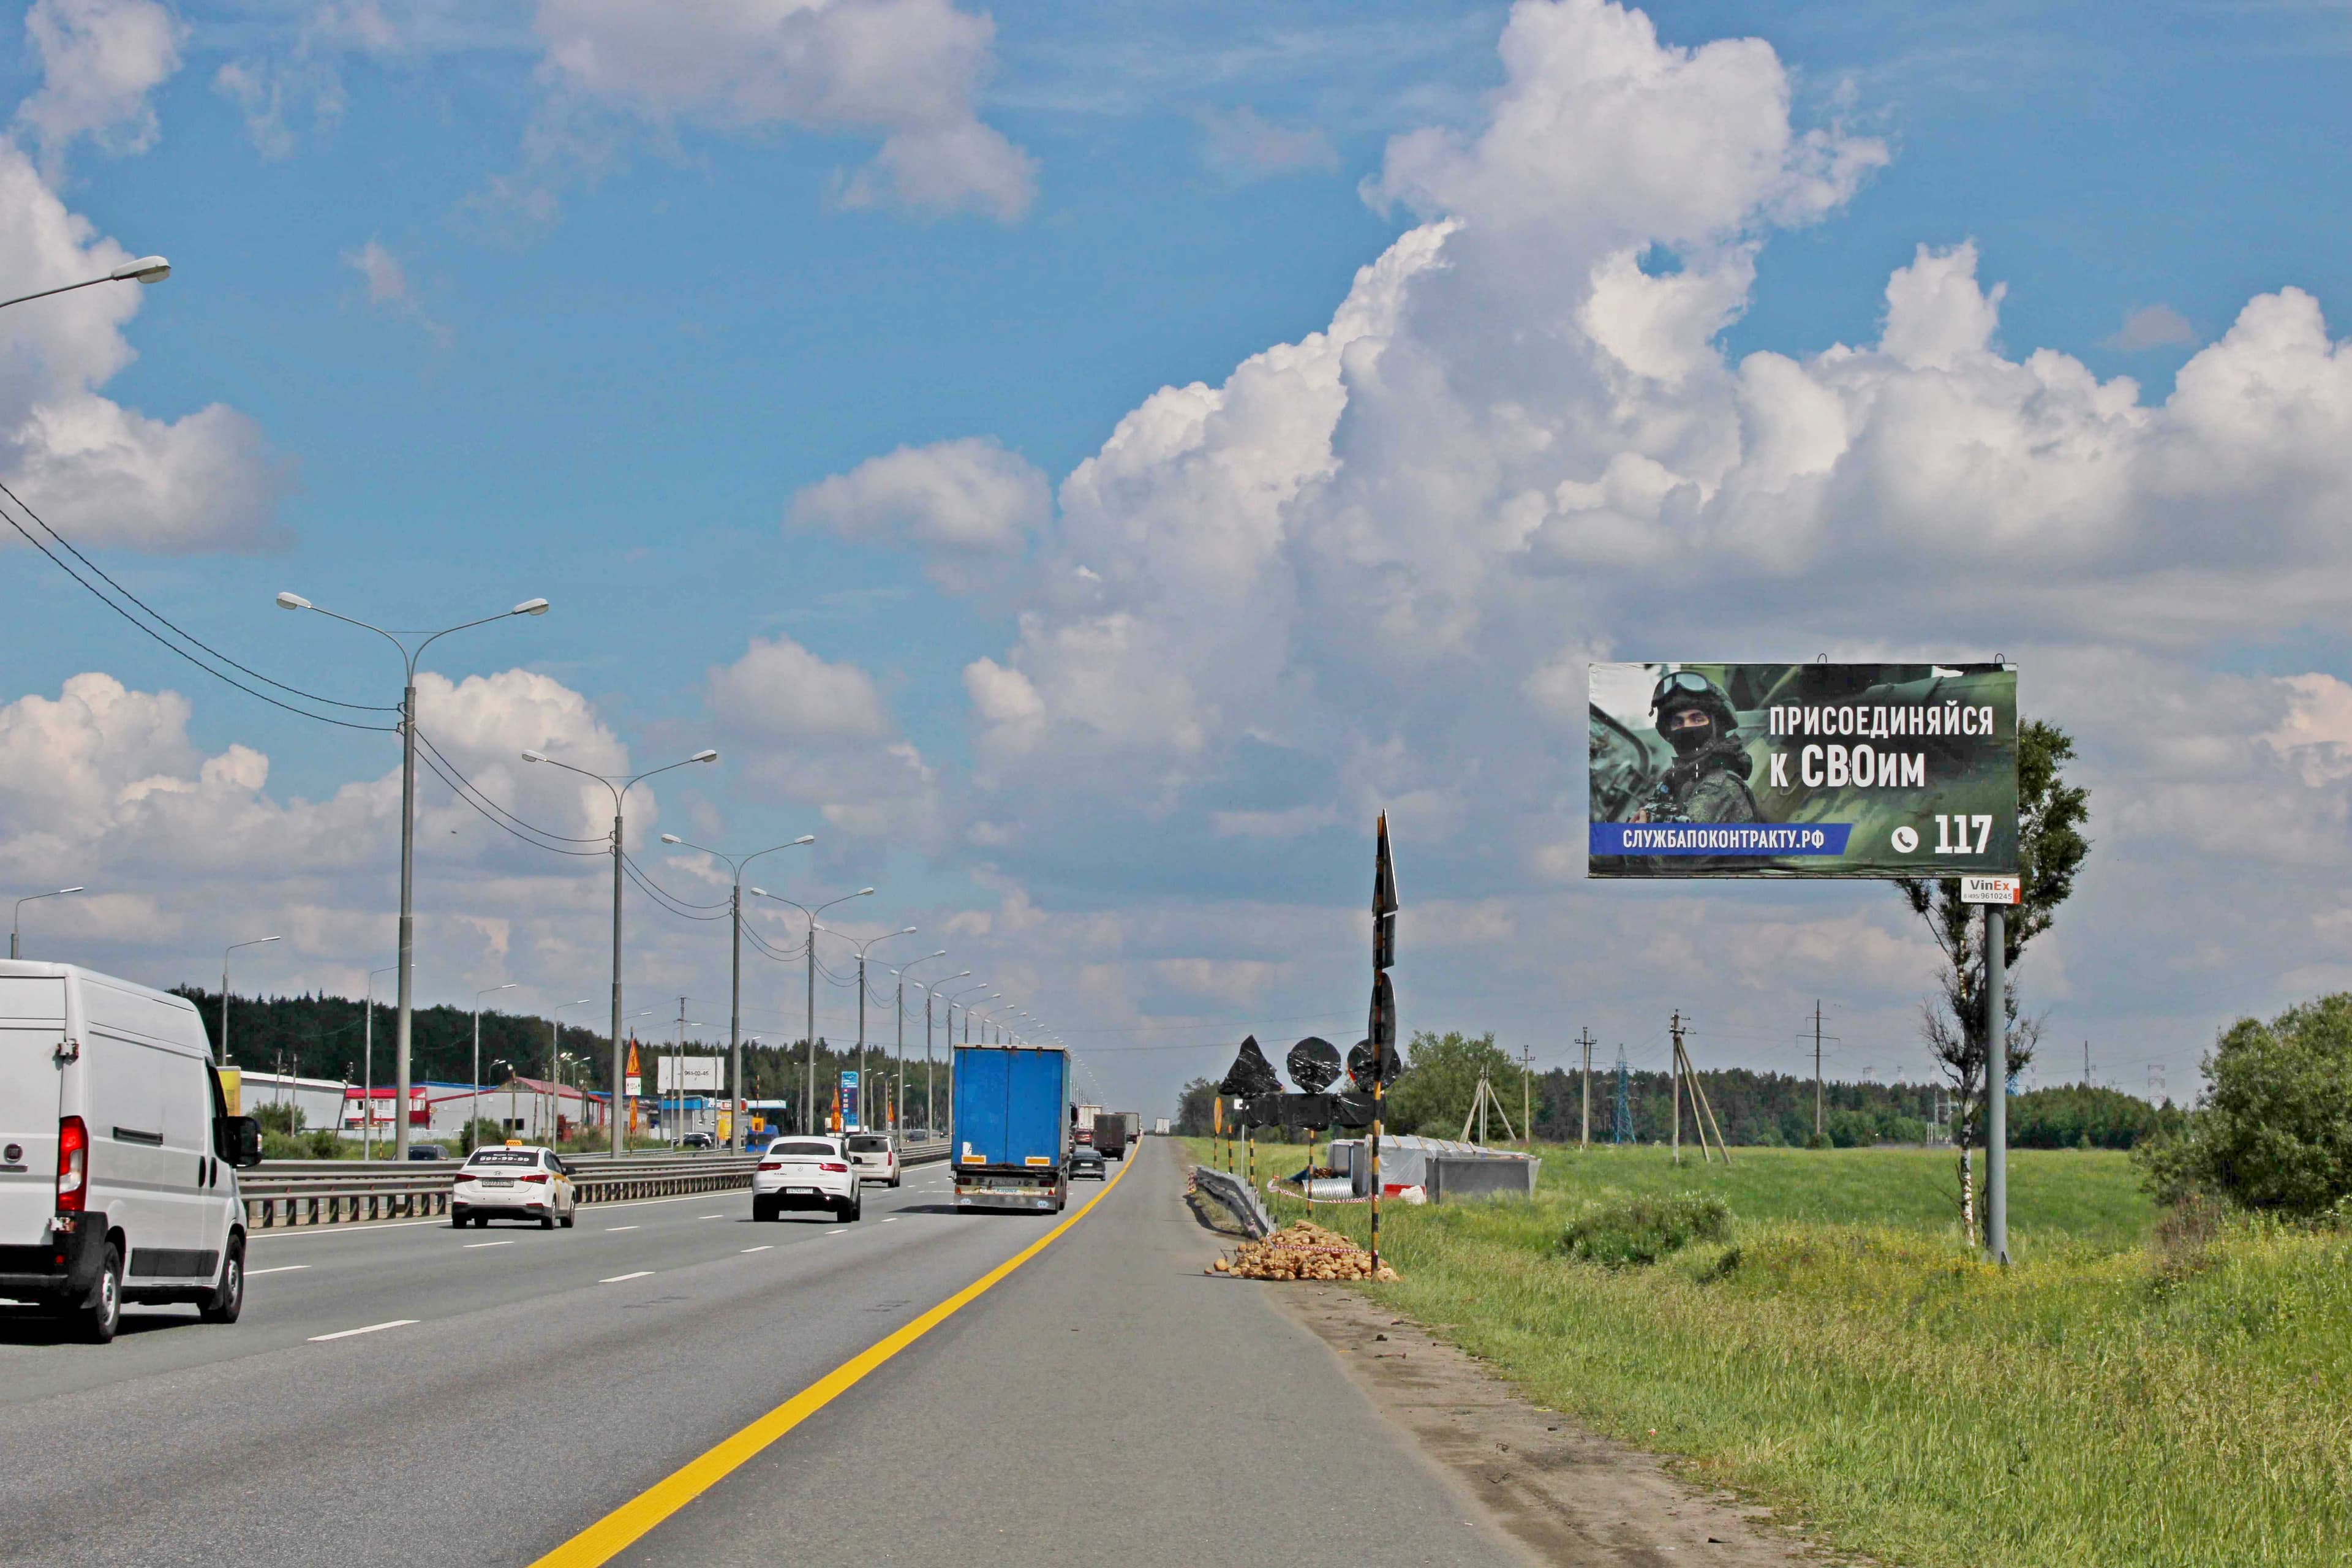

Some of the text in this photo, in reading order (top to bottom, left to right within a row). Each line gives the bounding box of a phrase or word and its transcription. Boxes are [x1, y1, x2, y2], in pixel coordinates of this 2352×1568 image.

[1770, 700, 1993, 739] ПРИСОЕДИНЯЙСЯ
[1623, 829, 1825, 849] СЛУЖБАПОКОНТРАКТУ.РФ
[1935, 815, 1992, 854] 117
[1970, 880, 2010, 891] VinEx
